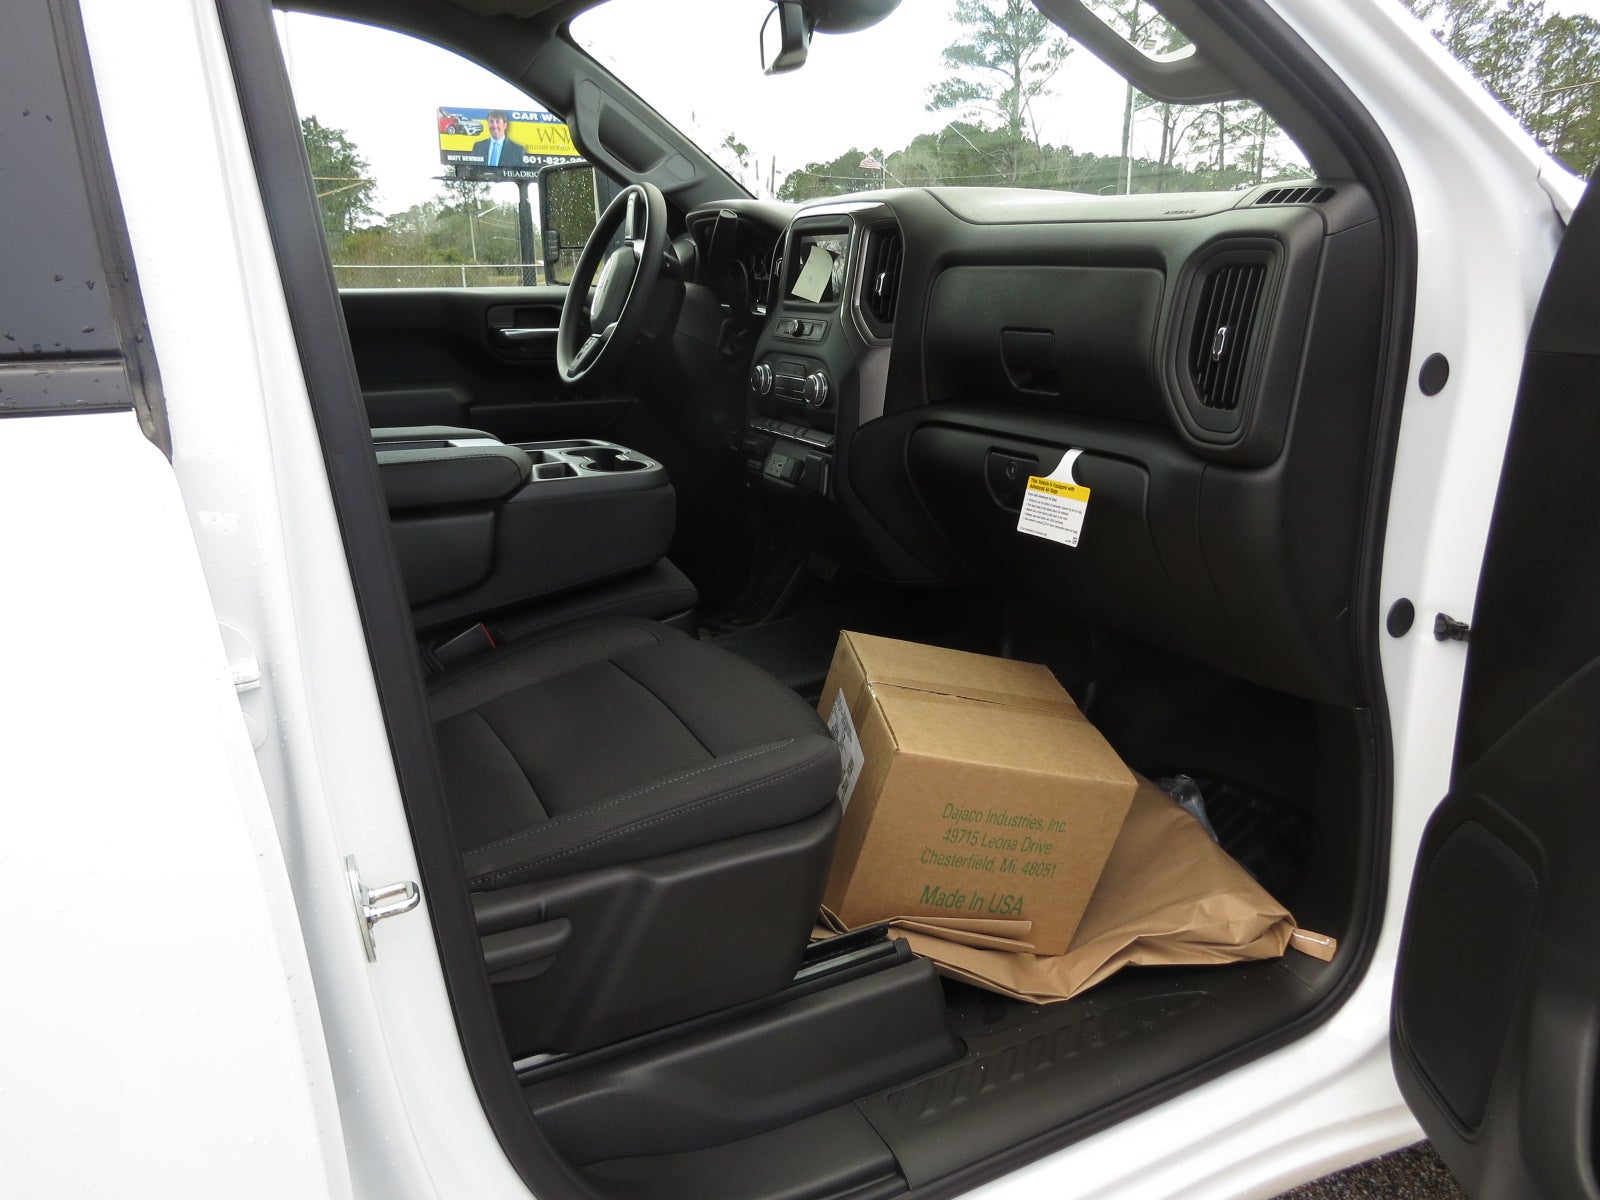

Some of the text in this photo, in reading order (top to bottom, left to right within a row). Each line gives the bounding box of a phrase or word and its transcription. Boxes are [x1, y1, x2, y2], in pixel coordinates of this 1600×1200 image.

[511, 111, 539, 121] CAR
[942, 803, 1068, 833] Dajaco Industries, Inc.
[942, 827, 1053, 855] 49715 Leona Drive
[921, 847, 1057, 878] Chesterfield, Mi. 48051
[919, 884, 1025, 916] Made In USA
